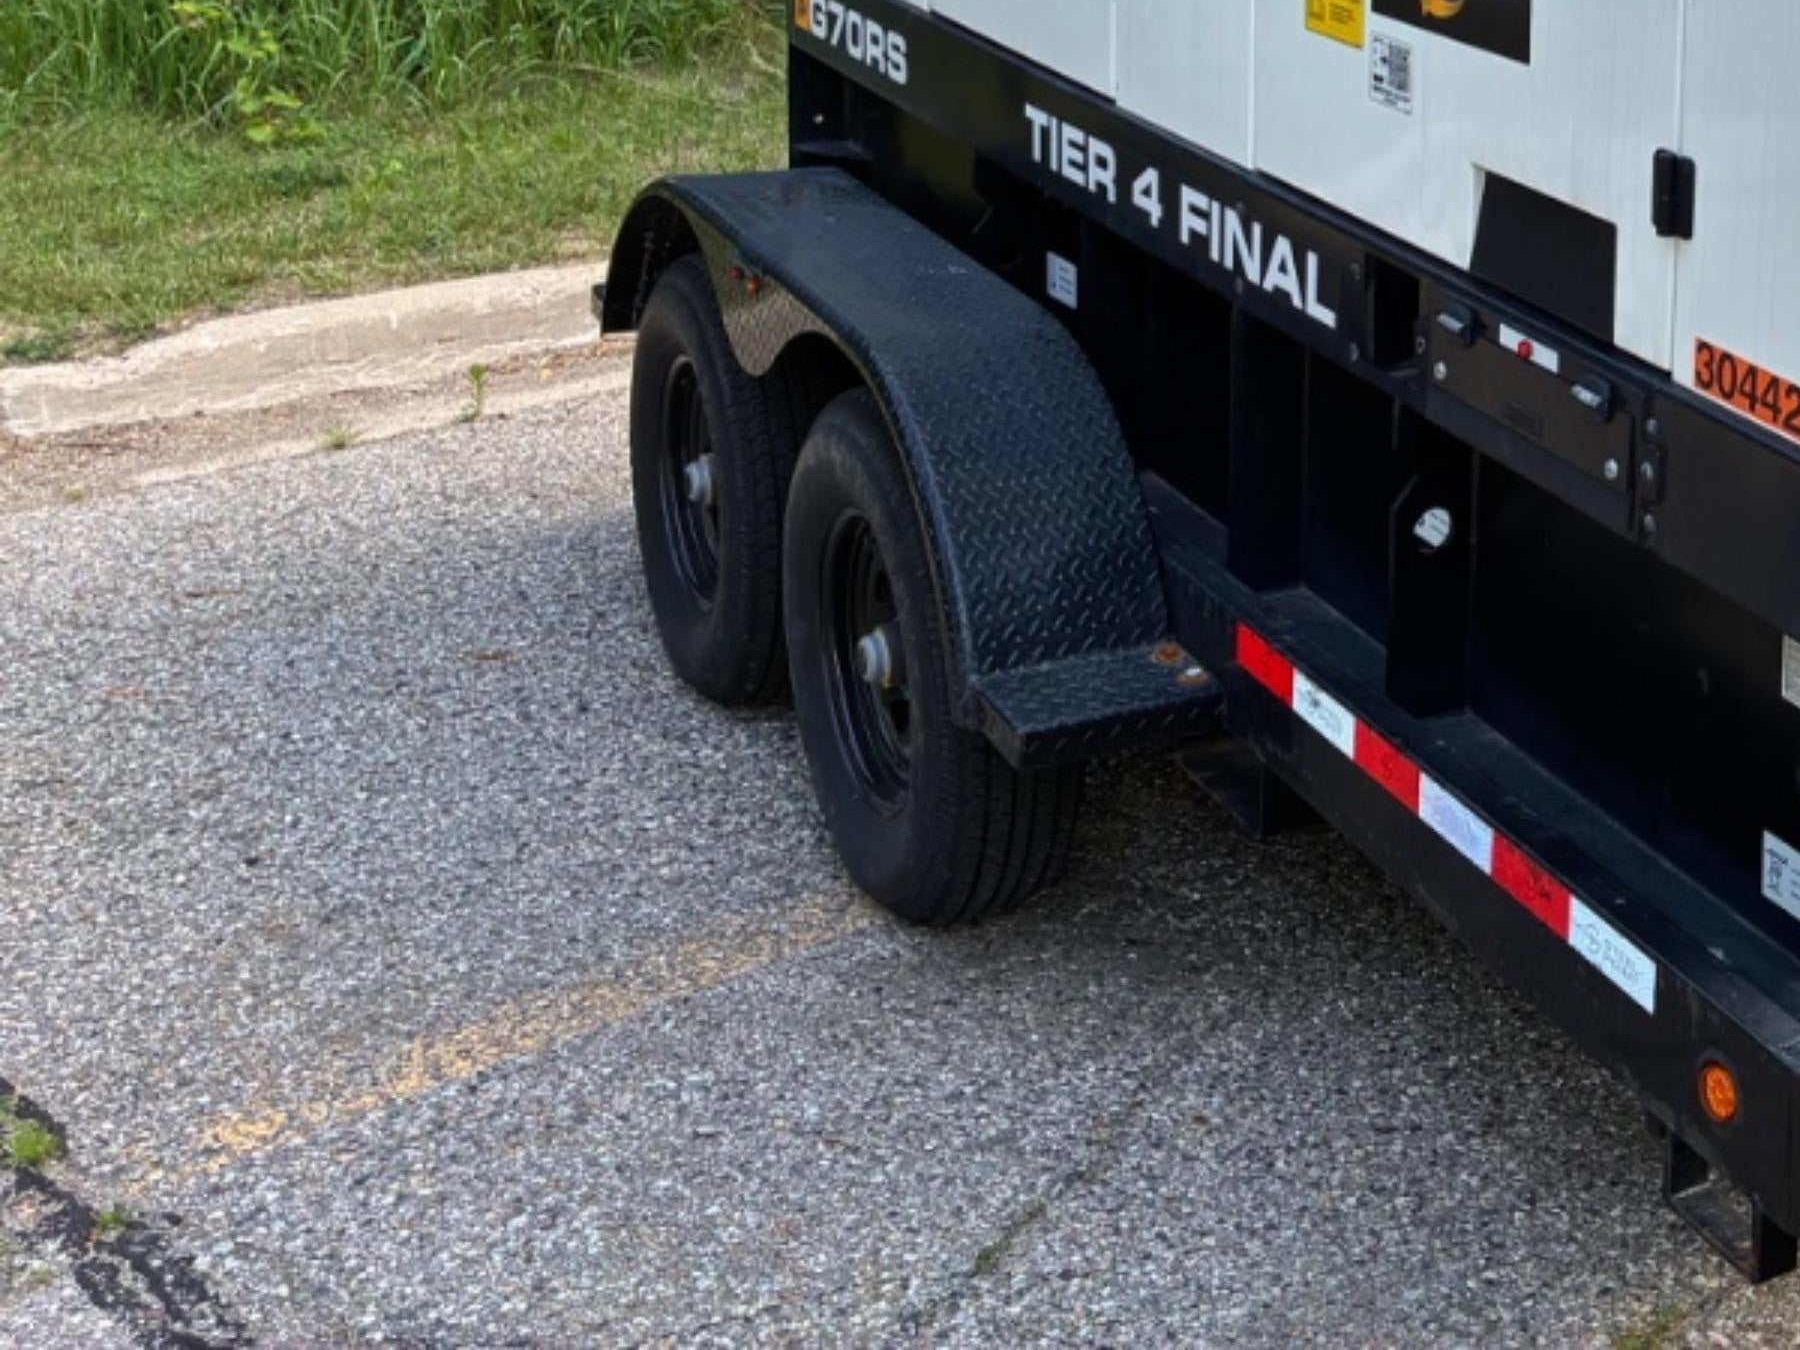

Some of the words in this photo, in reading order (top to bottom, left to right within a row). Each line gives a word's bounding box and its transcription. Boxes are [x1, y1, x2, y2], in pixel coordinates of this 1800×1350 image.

[1025, 102, 1117, 204] TIER
[1131, 165, 1164, 229] 4
[1178, 182, 1338, 331] FINAL
